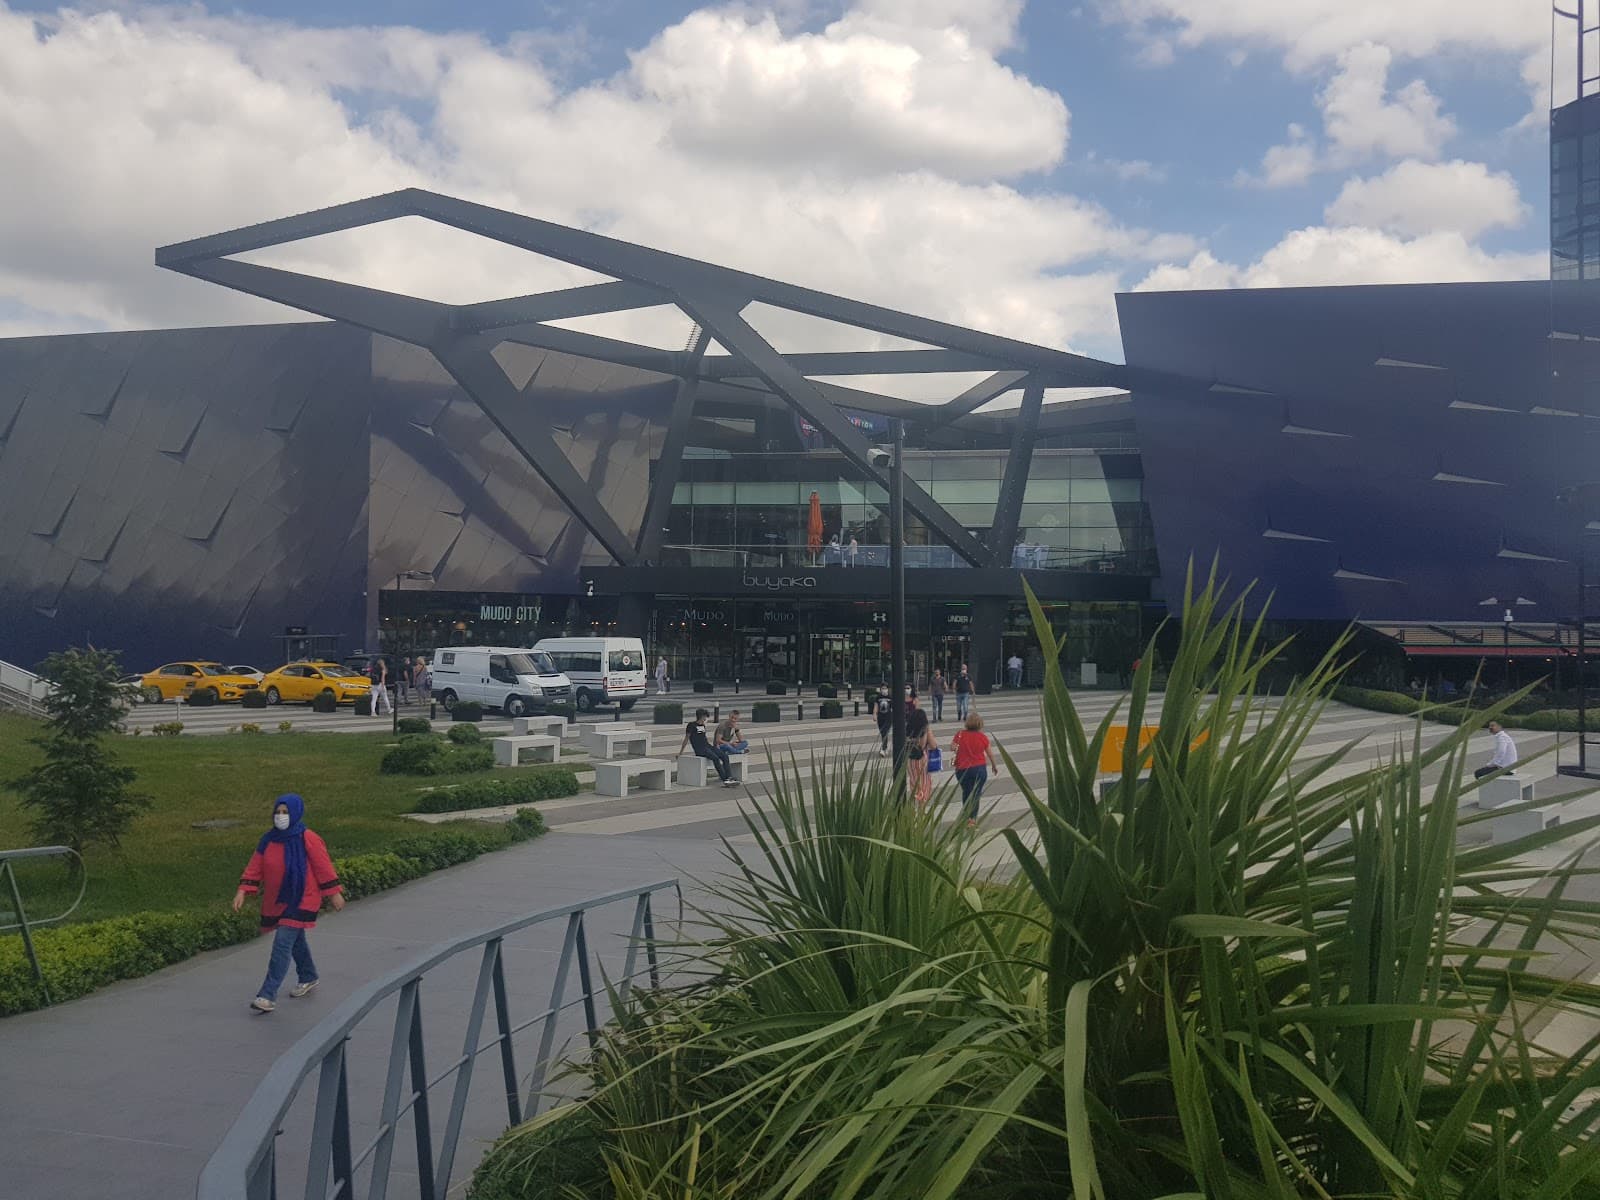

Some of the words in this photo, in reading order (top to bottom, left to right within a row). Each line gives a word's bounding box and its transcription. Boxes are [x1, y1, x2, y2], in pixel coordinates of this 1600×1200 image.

[743, 570, 817, 590] buyaka
[480, 605, 512, 621] MUDO
[516, 606, 542, 621] CITY
[683, 608, 725, 620] MUDO
